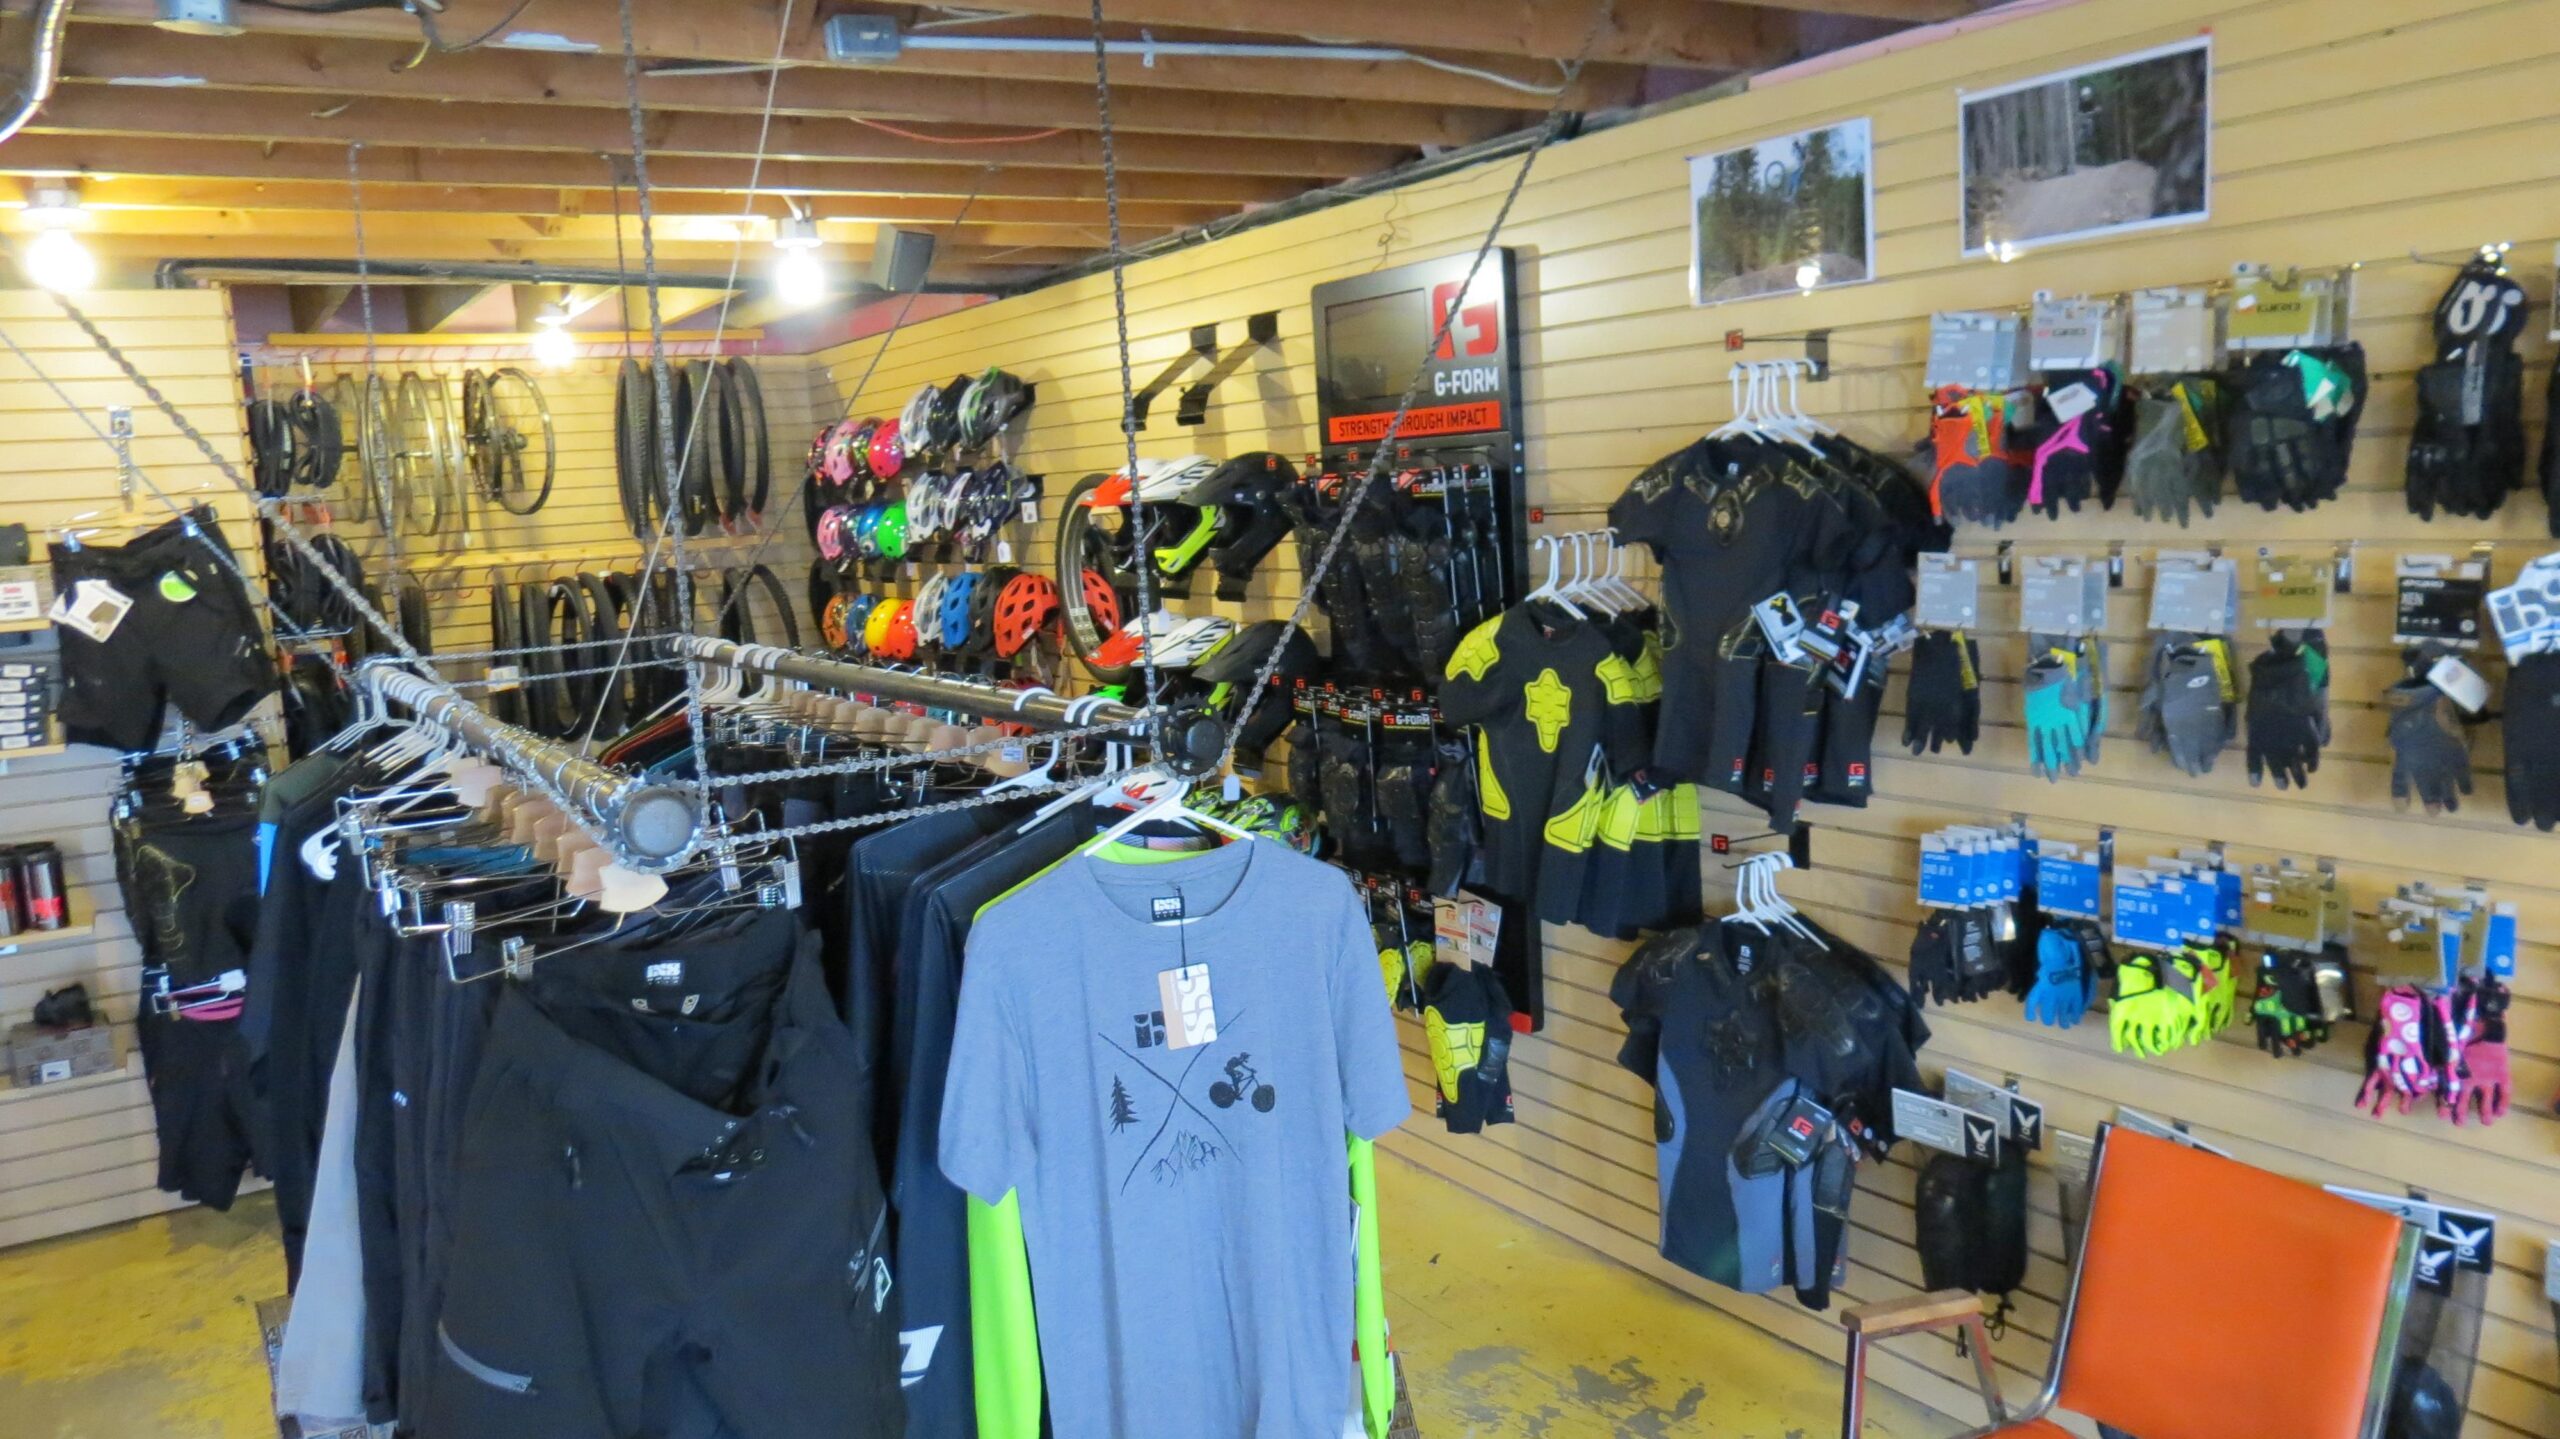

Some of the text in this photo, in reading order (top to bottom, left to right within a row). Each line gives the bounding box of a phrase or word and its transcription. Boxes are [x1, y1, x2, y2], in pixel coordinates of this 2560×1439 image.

[1434, 367, 1499, 396] G-FORM
[1339, 418, 1389, 437] STRENGTH
[1446, 408, 1487, 427] IMPACT
[1396, 714, 1431, 725] G-FORM
